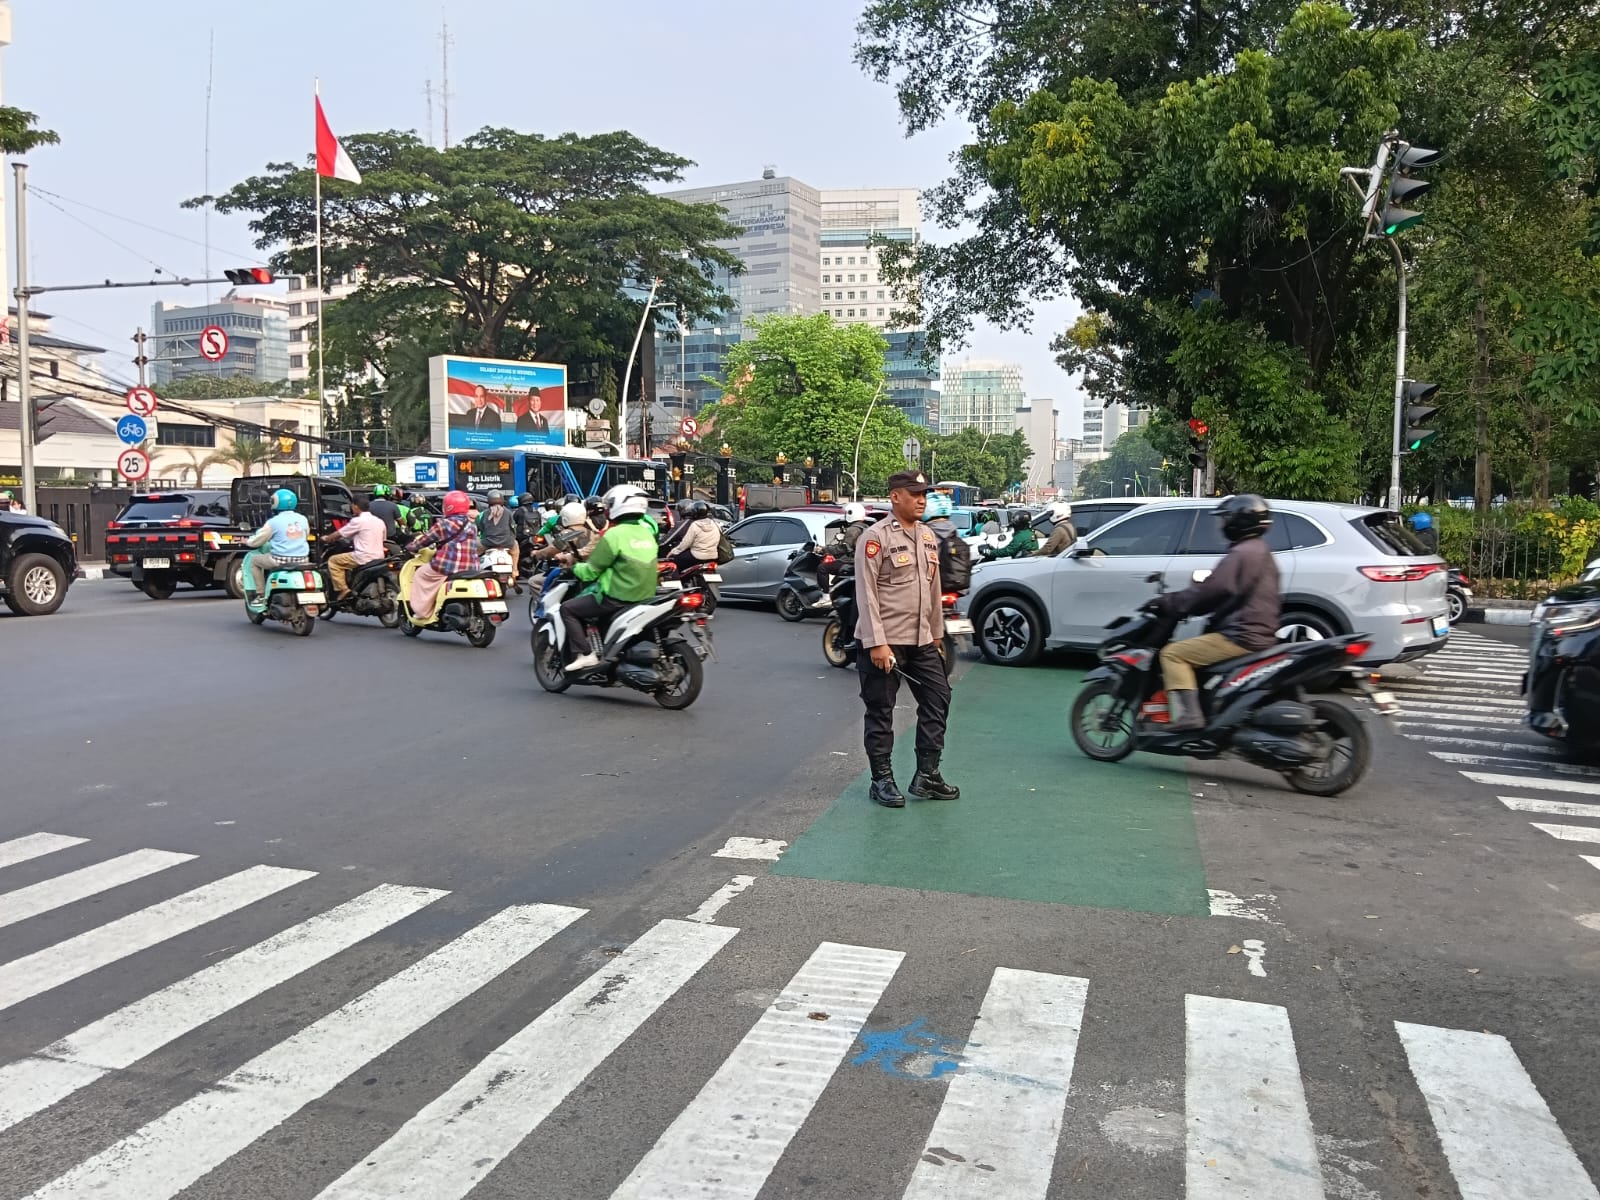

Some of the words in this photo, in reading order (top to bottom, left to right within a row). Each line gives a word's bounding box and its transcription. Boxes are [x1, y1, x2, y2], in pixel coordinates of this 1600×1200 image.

[741, 216, 786, 225] PERDAGANGAN
[124, 457, 139, 473] 25
[480, 474, 501, 482] Listrik
